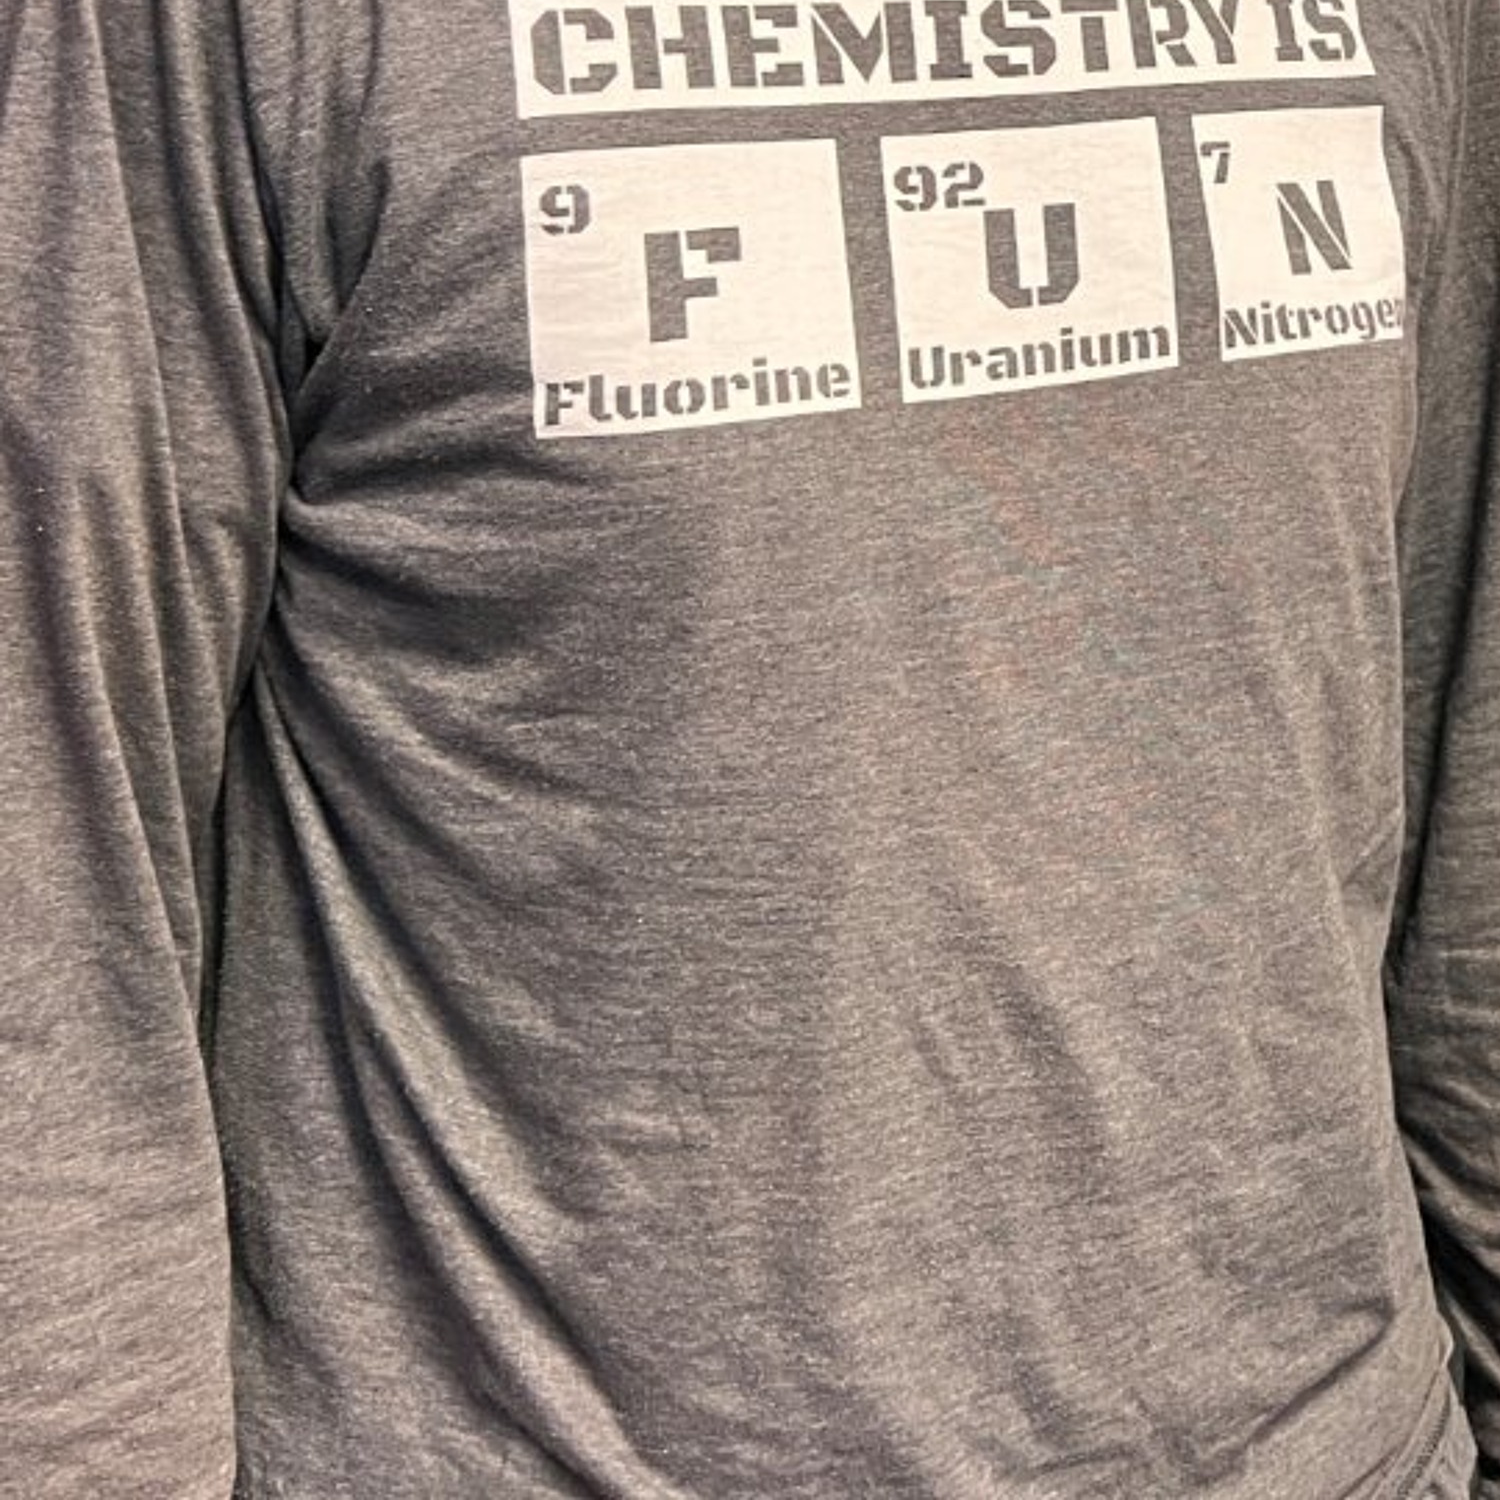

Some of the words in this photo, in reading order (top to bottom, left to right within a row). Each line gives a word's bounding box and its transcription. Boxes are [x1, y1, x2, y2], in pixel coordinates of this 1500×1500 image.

[893, 161, 986, 212] 92
[1200, 141, 1231, 185] 7
[538, 184, 591, 236] 9
[1275, 180, 1353, 276] N
[643, 226, 742, 343] F
[983, 202, 1081, 309] U
[1223, 297, 1402, 349] Nitroge
[907, 325, 1171, 389] Uranium
[544, 357, 851, 426] Fluorine
